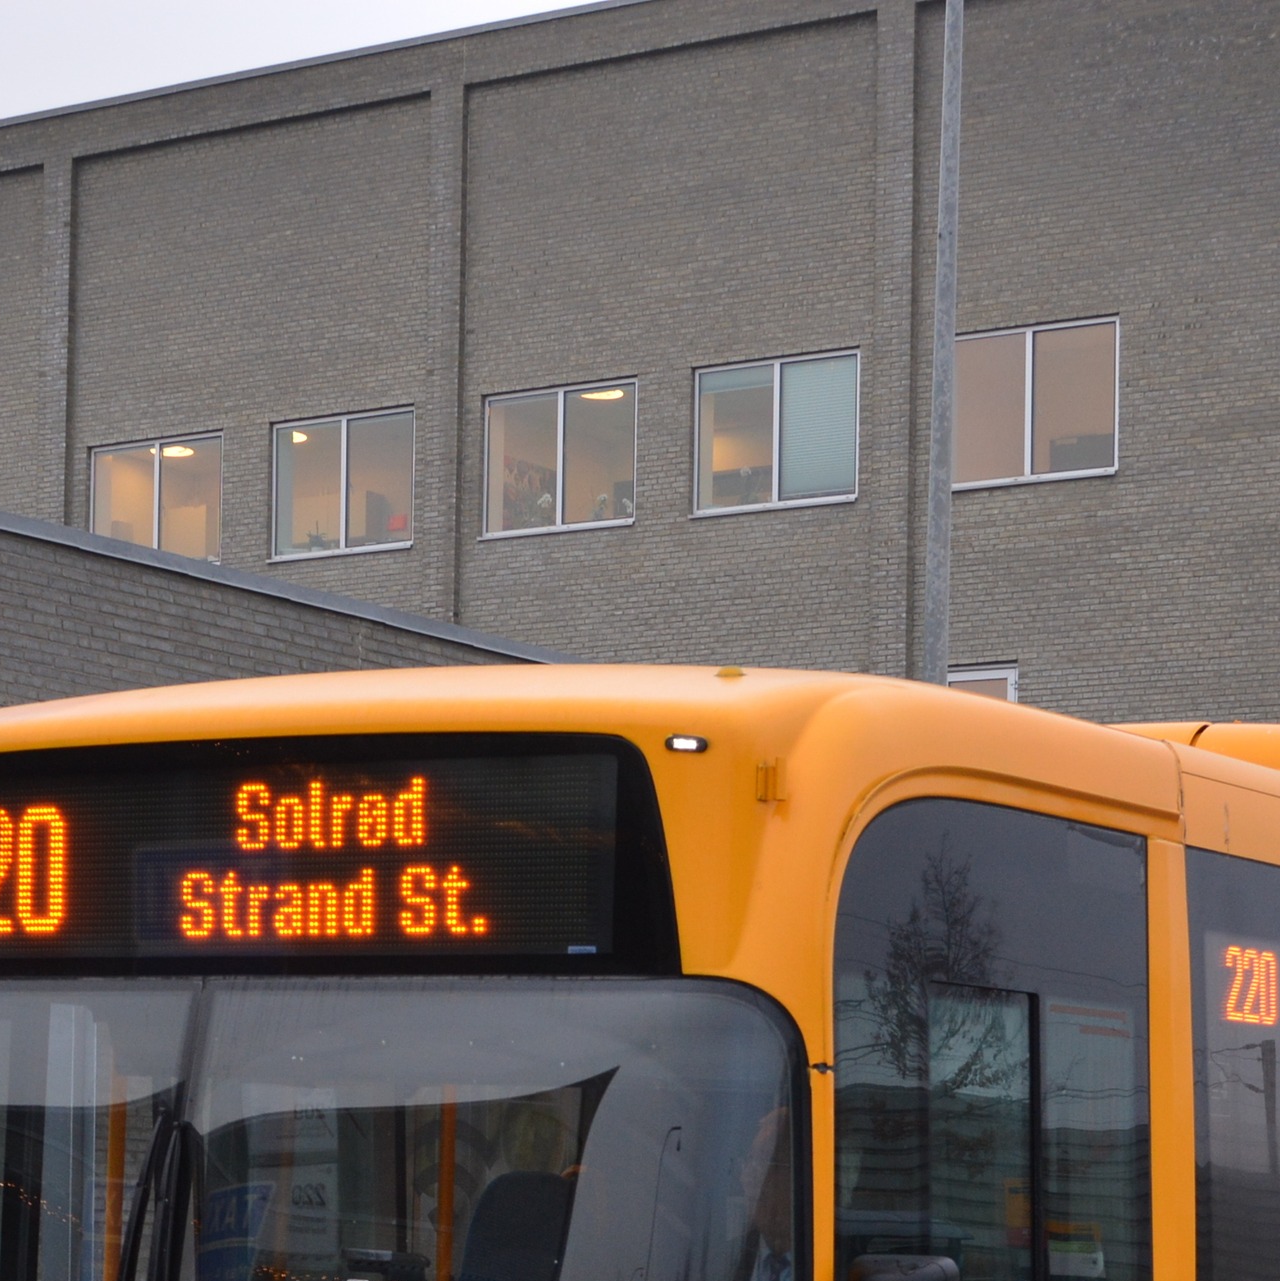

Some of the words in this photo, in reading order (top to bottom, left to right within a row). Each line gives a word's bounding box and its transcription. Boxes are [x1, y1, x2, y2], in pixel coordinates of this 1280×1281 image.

[235, 777, 427, 851] Solrød
[180, 868, 377, 938] Strand
[399, 863, 489, 937] St.
[1225, 946, 1276, 1025] 220
